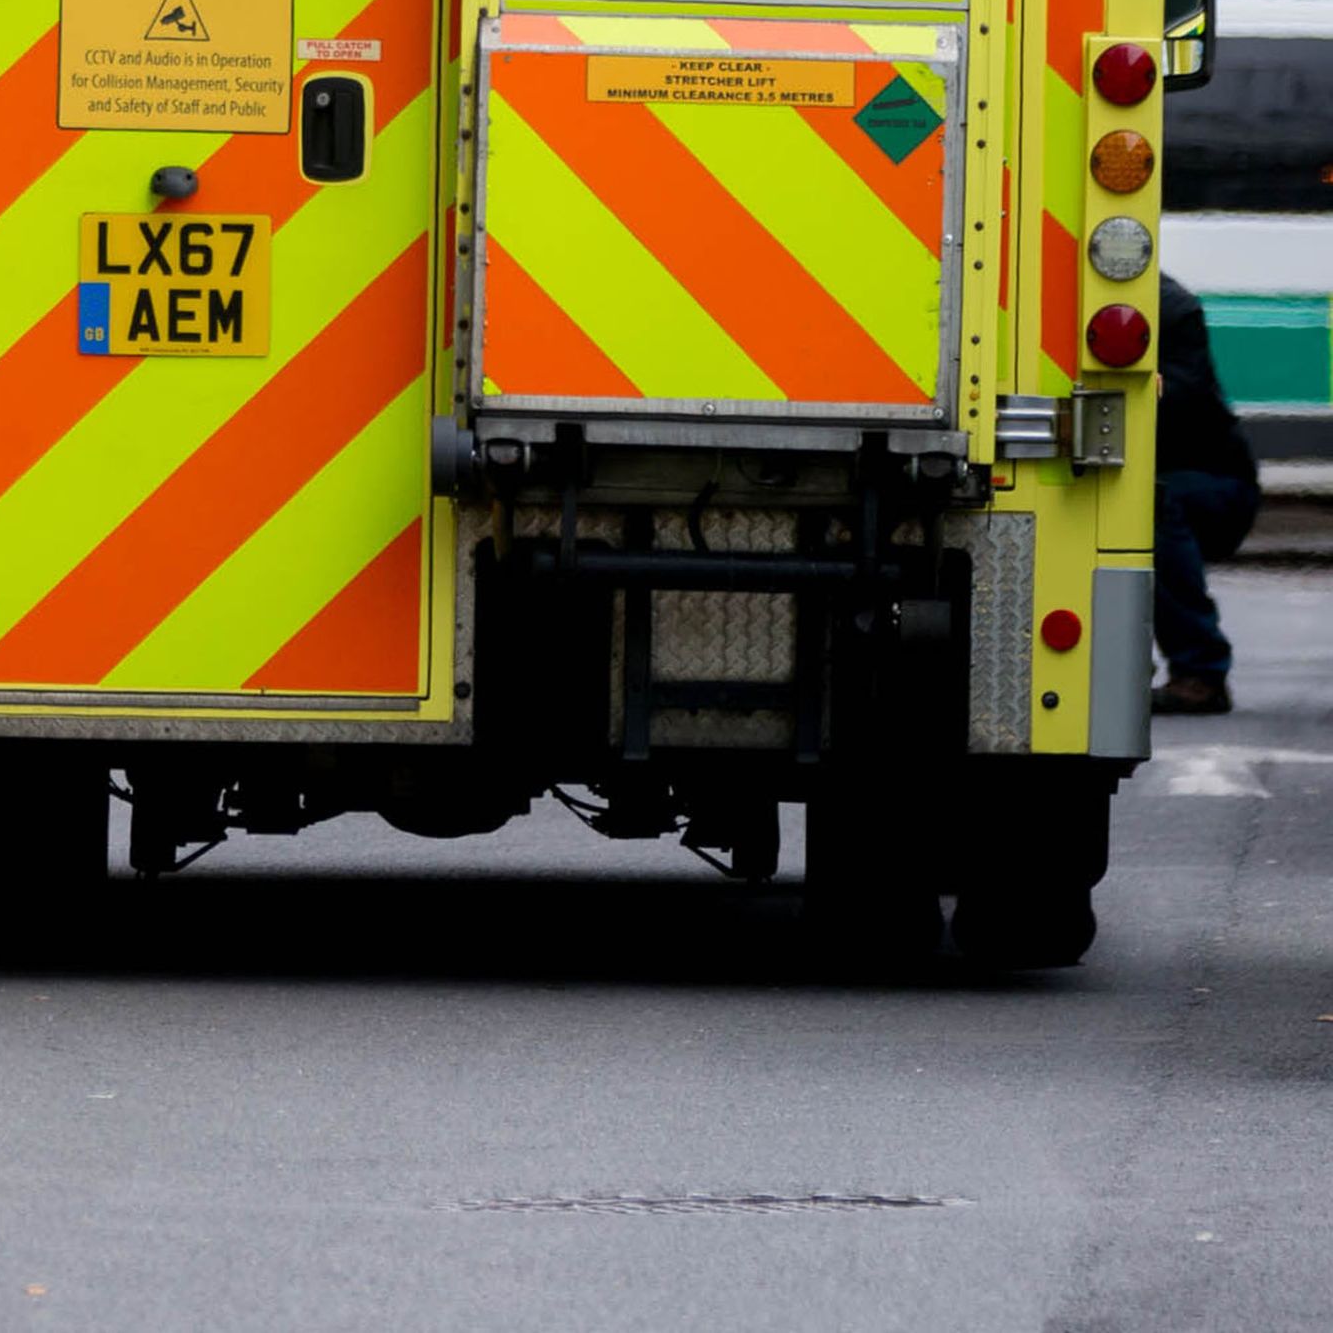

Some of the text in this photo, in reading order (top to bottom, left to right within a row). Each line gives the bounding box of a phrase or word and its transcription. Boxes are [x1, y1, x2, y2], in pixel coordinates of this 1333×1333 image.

[307, 41, 372, 50] PULL CATCH
[85, 50, 272, 72] CCTV and Audio is in Operation
[680, 62, 714, 72] KEEP
[718, 62, 762, 73] CLEAR
[71, 74, 283, 96] for Collision Management, Security
[665, 75, 776, 88] STRETCHER LIFT
[607, 89, 834, 103] MINIMUM CLEARANCE 3.5 METRES
[88, 98, 267, 116] and Safety of Staff and Public
[97, 222, 254, 277] LX67
[127, 288, 243, 343] AEM
[84, 327, 105, 341] GB
